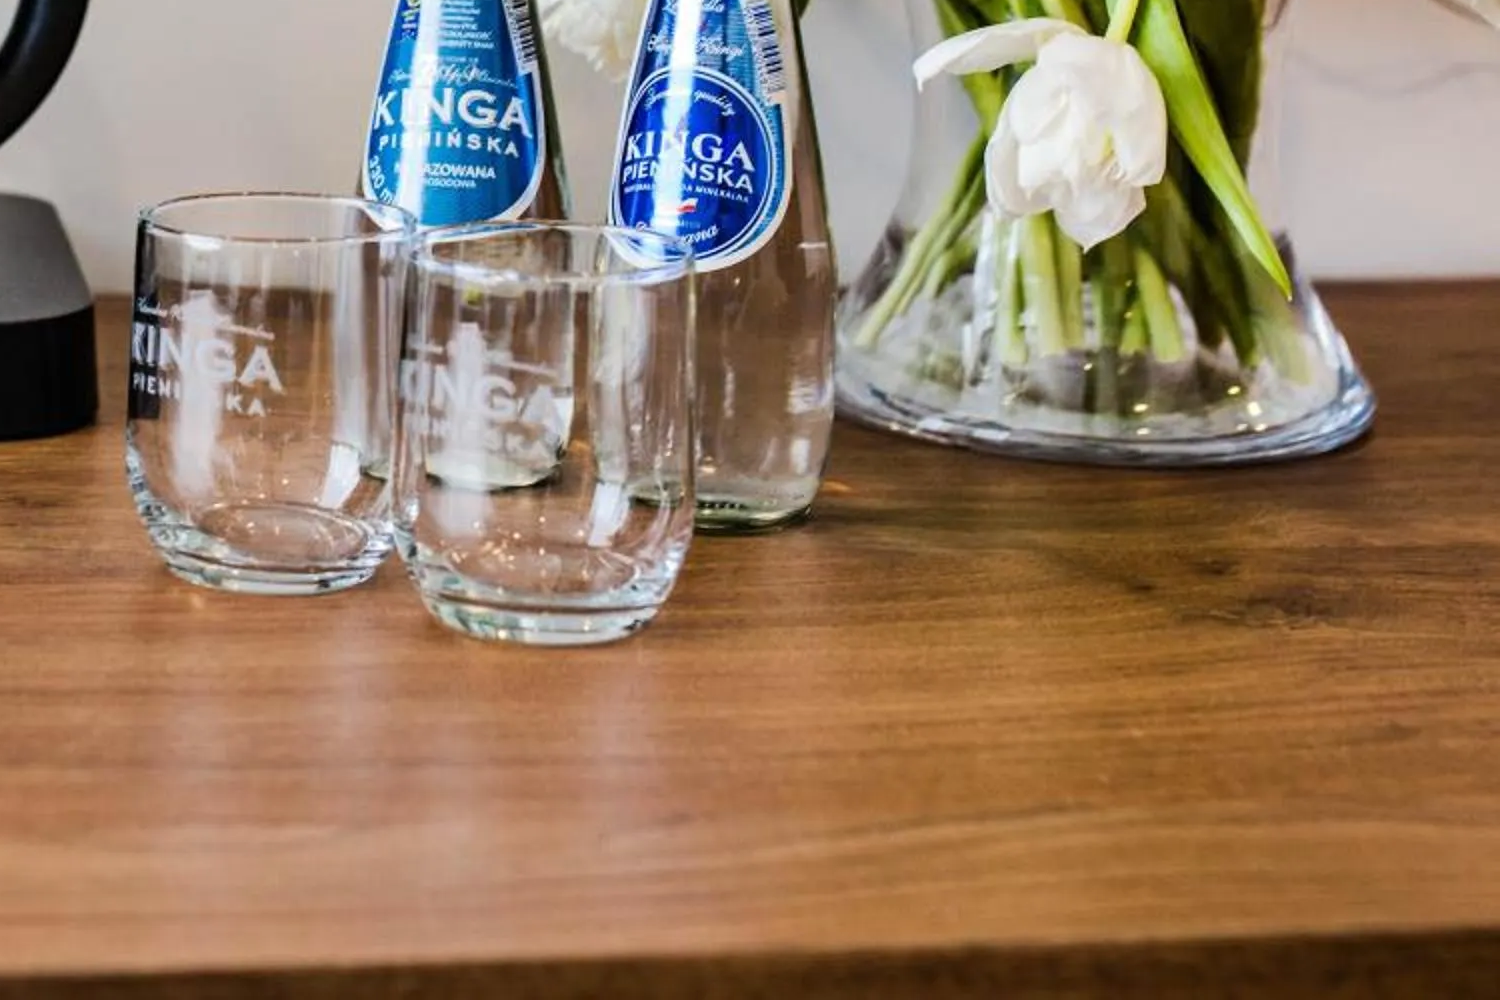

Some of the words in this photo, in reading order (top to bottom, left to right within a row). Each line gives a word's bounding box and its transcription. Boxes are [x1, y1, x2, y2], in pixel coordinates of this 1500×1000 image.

[373, 87, 533, 139] KINGA
[626, 130, 756, 172] KINGA
[132, 322, 285, 397] KINGA
